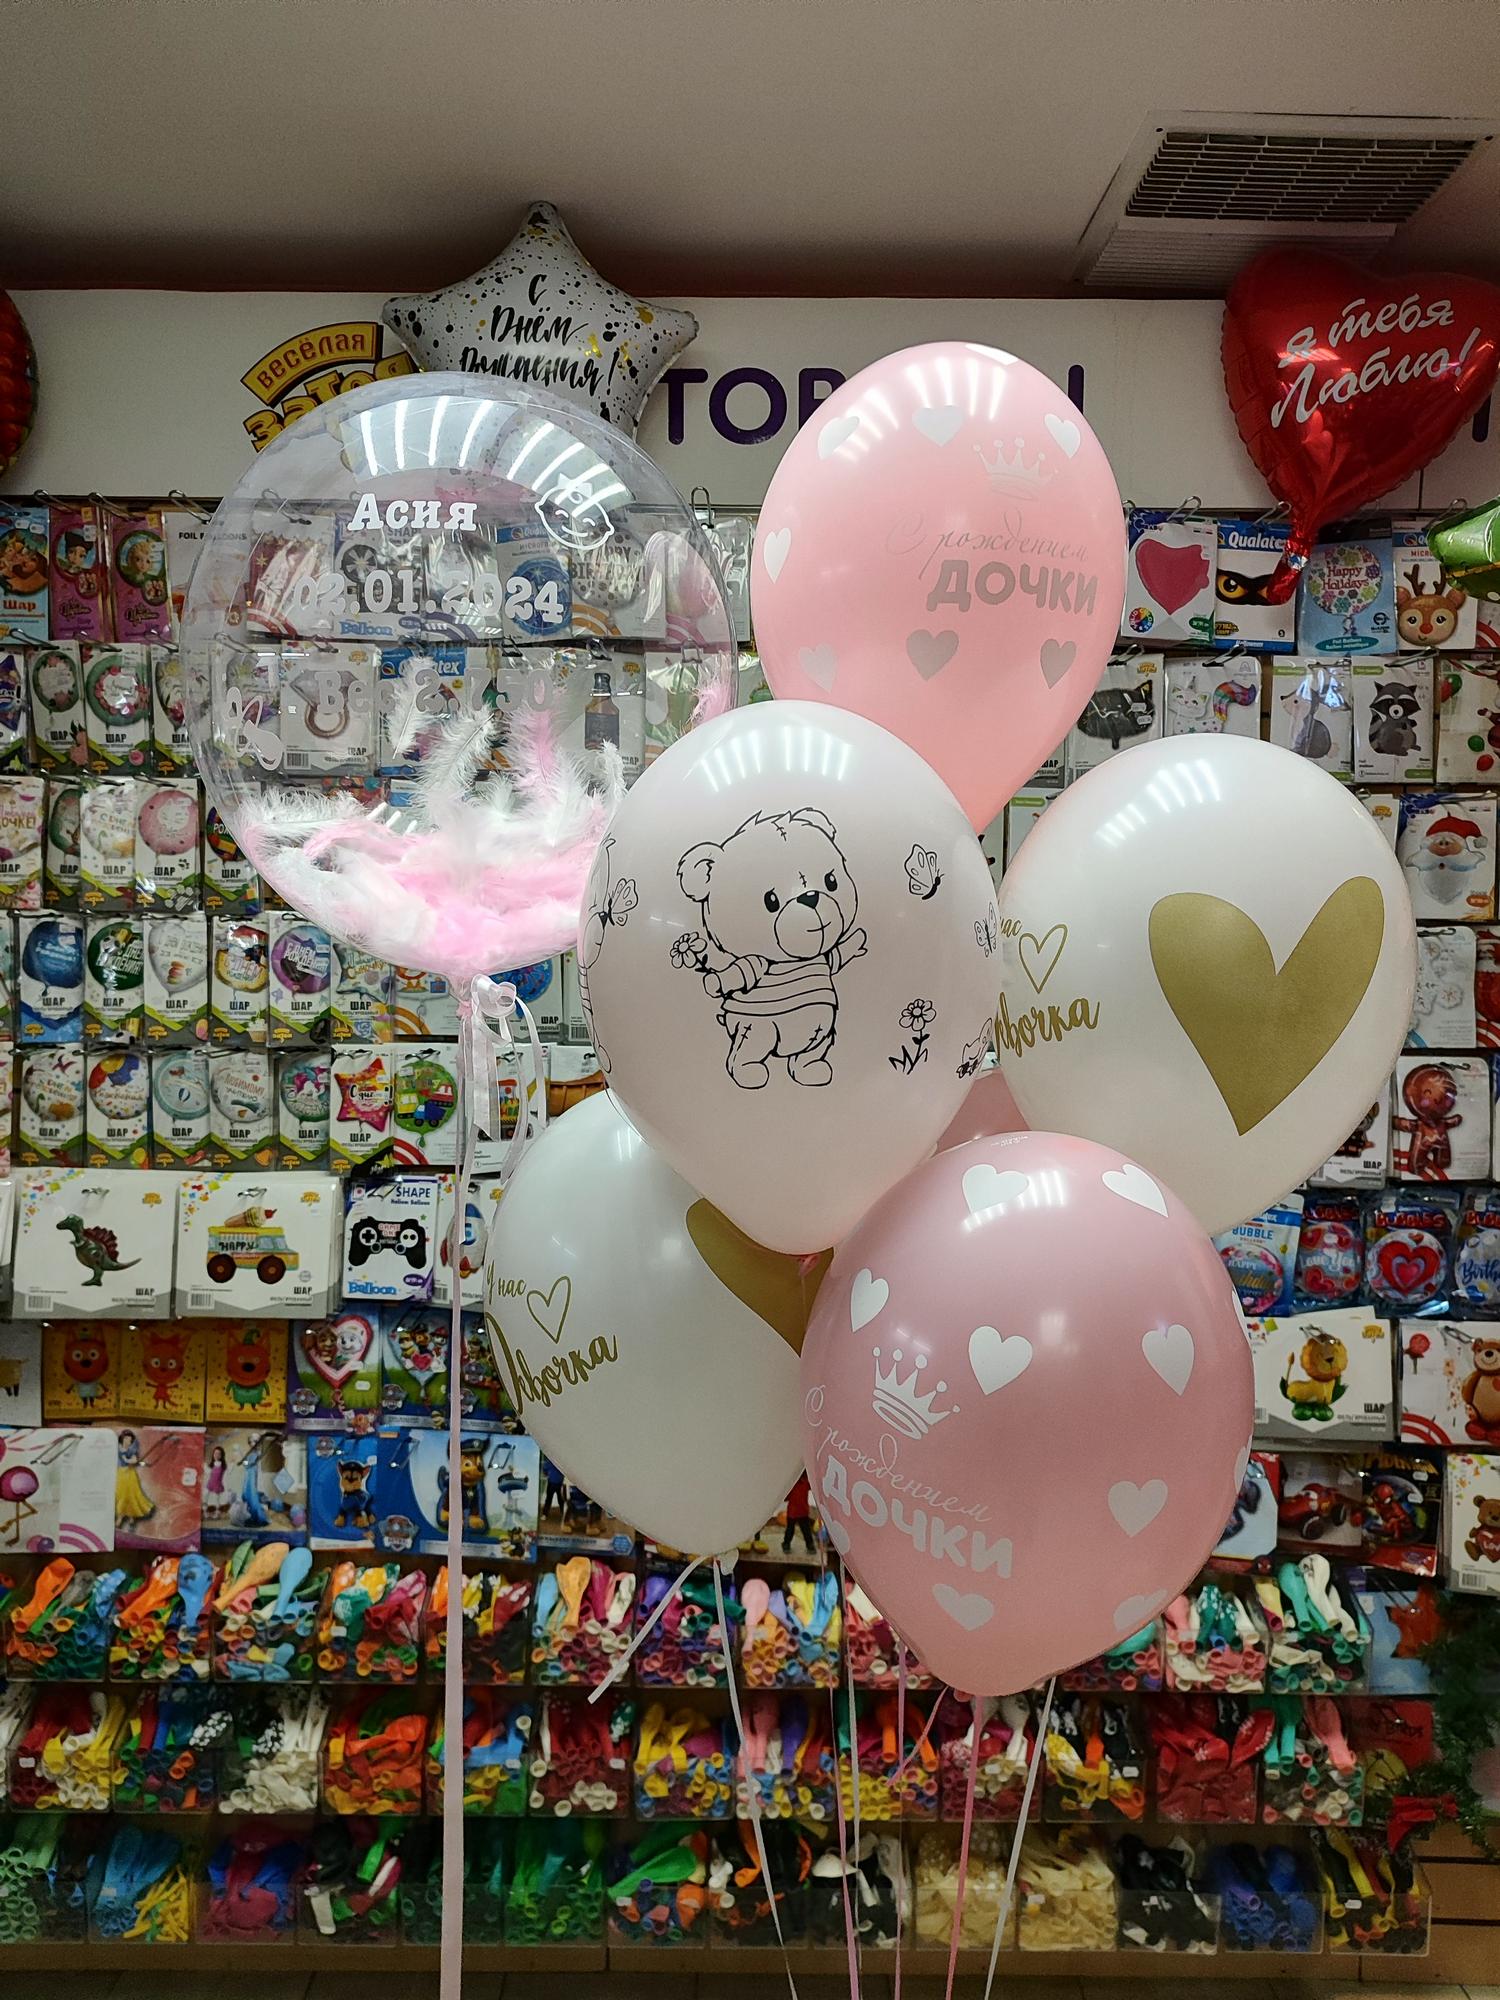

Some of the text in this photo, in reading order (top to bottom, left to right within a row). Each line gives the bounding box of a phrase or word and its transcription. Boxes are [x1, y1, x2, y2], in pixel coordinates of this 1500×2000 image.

[528, 273, 549, 307] С
[1277, 293, 1455, 369] Я тебя
[256, 332, 365, 392] весёлая
[1270, 326, 1481, 429] Люблю!
[347, 493, 478, 531] Асия
[178, 532, 198, 540] FOIL
[1228, 532, 1289, 550] Qualate
[918, 506, 1088, 580] рождением
[1327, 564, 1363, 578] Happy
[926, 559, 1098, 616] ДОЧКИ
[1322, 578, 1370, 591] Holidays
[293, 569, 565, 624] 02.01.2024
[3, 600, 37, 612] Шар
[50, 730, 69, 740] ШАР
[105, 733, 127, 743] ШАР
[0, 817, 37, 830] ОЧКЕ!
[59, 865, 79, 874] ШАР
[103, 866, 127, 874] ШАР
[154, 867, 176, 876] ШАР
[221, 869, 242, 878] ШАР
[42, 997, 66, 1006] ШАР
[103, 998, 125, 1007] ШАР
[166, 1000, 188, 1009] ШАР
[229, 1001, 250, 1010] ШАР
[291, 1001, 313, 1010] ШАР
[350, 1001, 372, 1010] ШАР
[541, 1016, 559, 1024] ШАР
[39, 1128, 60, 1137] ШАР
[107, 1128, 128, 1137] ШАР
[172, 1127, 193, 1137] ШАР
[229, 1129, 251, 1139] ШАР
[298, 1130, 320, 1139] ШАР
[350, 1133, 372, 1142] ШАР
[1363, 1160, 1382, 1169] ШАР
[396, 1186, 431, 1198] SHAPE
[136, 1288, 156, 1297] ШАР
[293, 1286, 313, 1296] ШАР
[498, 1277, 527, 1298] нас
[1364, 1403, 1385, 1413] ШАР
[822, 1454, 1014, 1580] ДОЧКИ
